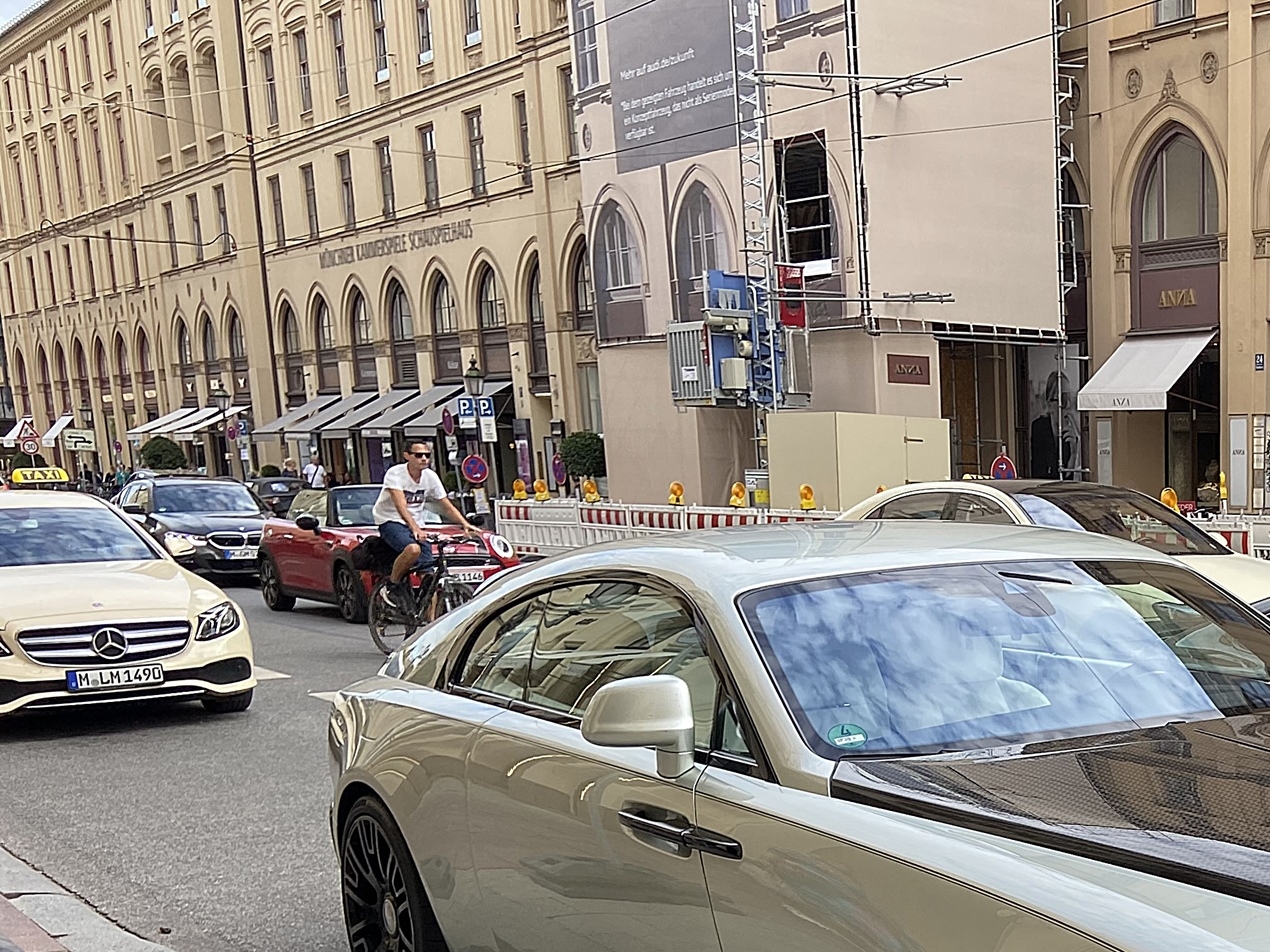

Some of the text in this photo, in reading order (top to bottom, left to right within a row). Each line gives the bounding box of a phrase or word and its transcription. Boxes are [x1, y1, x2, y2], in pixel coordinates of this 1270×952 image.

[26, 443, 36, 451] 30
[22, 470, 60, 480] TAXI
[79, 672, 90, 687] M
